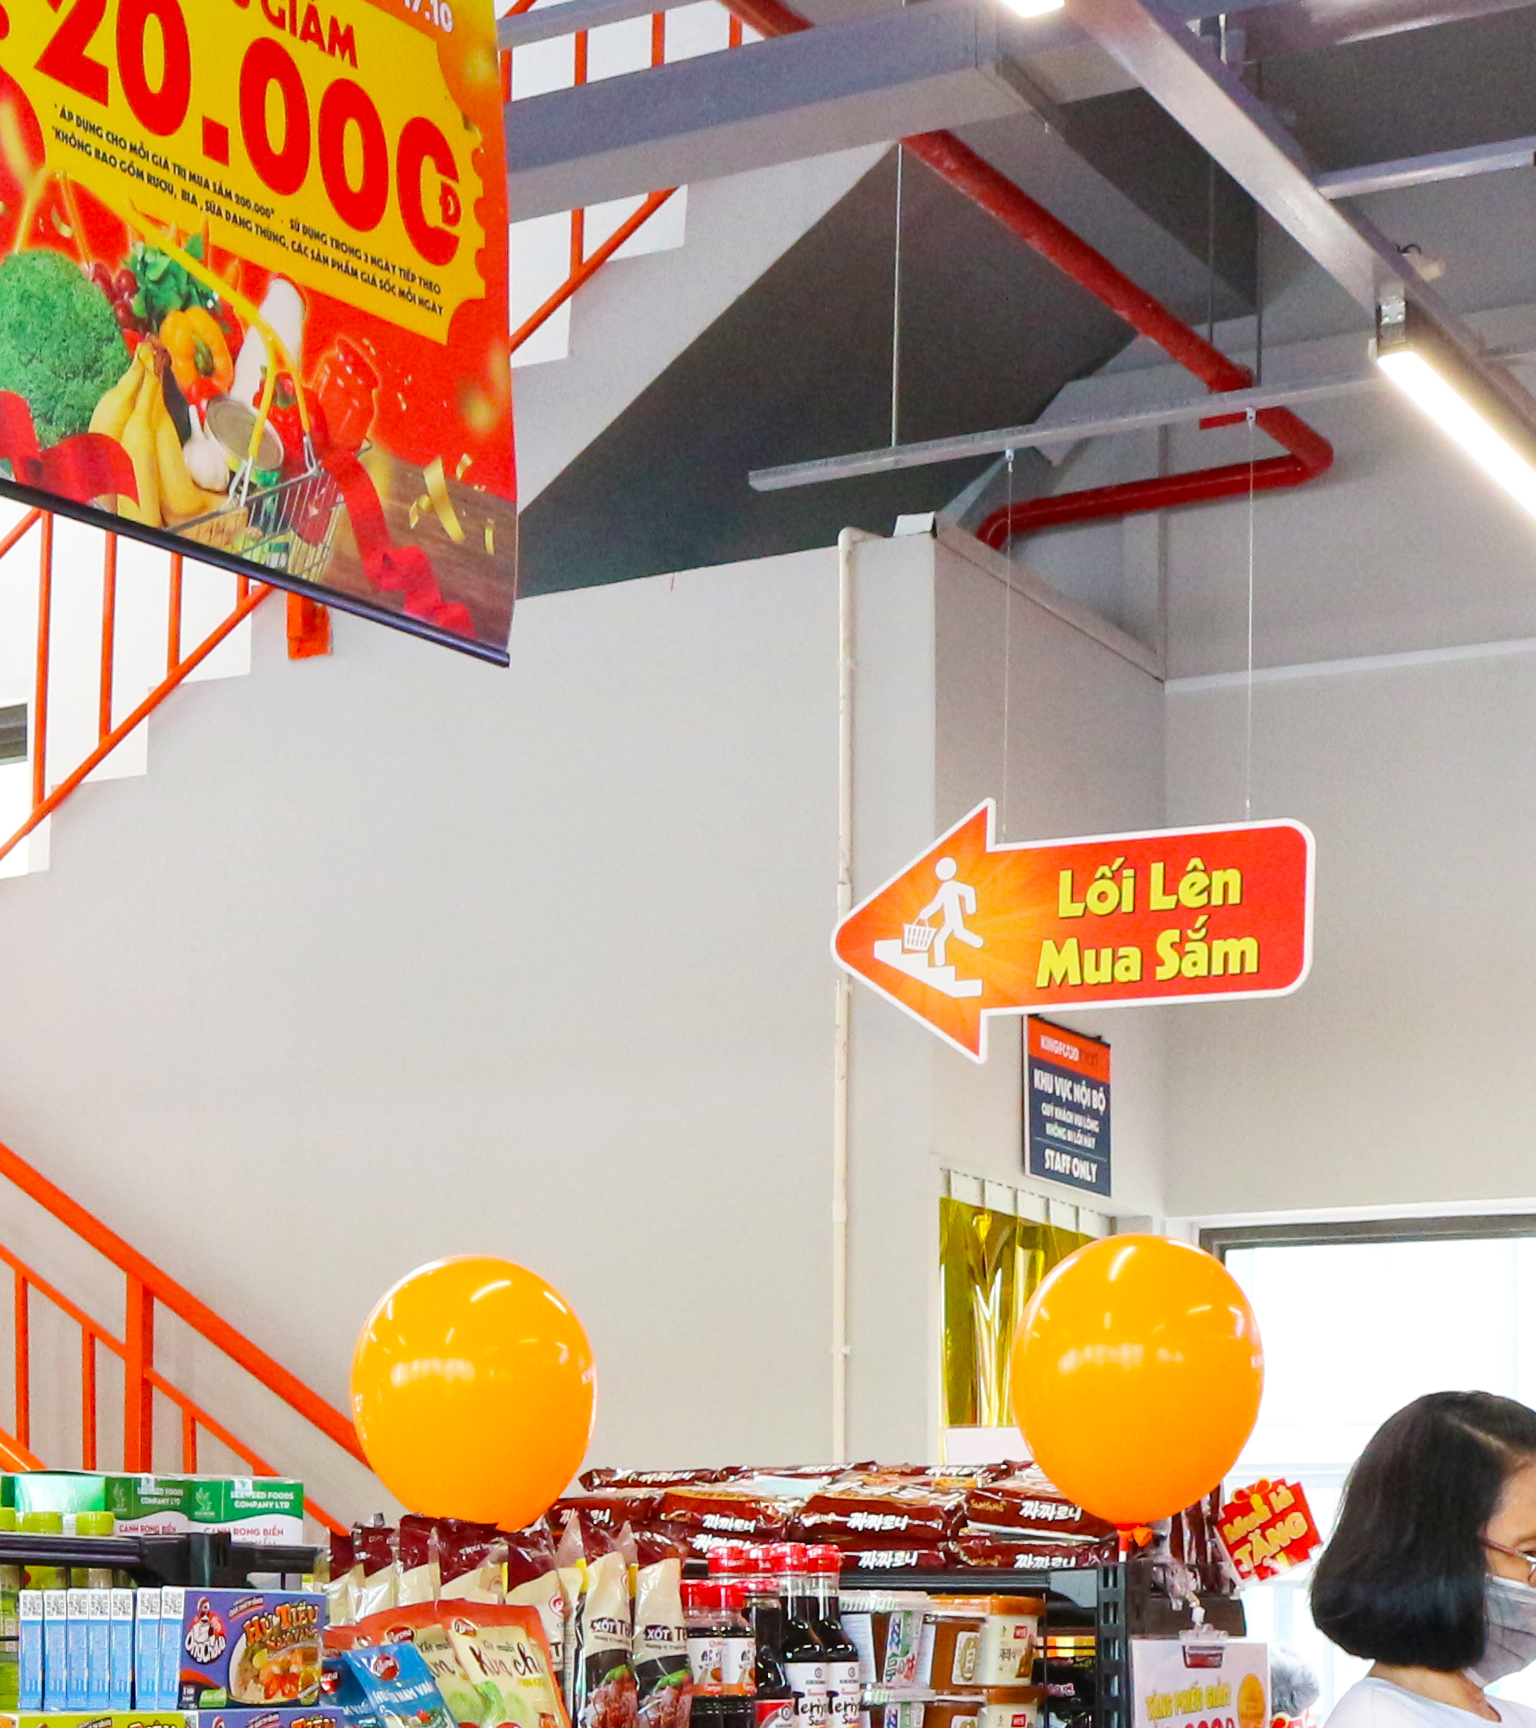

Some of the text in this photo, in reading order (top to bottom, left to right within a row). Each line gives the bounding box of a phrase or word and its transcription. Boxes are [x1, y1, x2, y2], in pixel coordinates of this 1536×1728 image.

[106, 131, 127, 149] CHO
[188, 170, 210, 189] MUA
[95, 148, 117, 168] BAO
[291, 240, 308, 257] CÁC
[330, 236, 362, 260] TRONG
[419, 276, 441, 295] THEO
[1057, 856, 1244, 919] Lối Lên
[1035, 915, 1260, 988] Mua Sắm
[1033, 1068, 1054, 1094] KHU
[1044, 1148, 1097, 1183] STAFF ONLY
[233, 1528, 260, 1536] RONG
